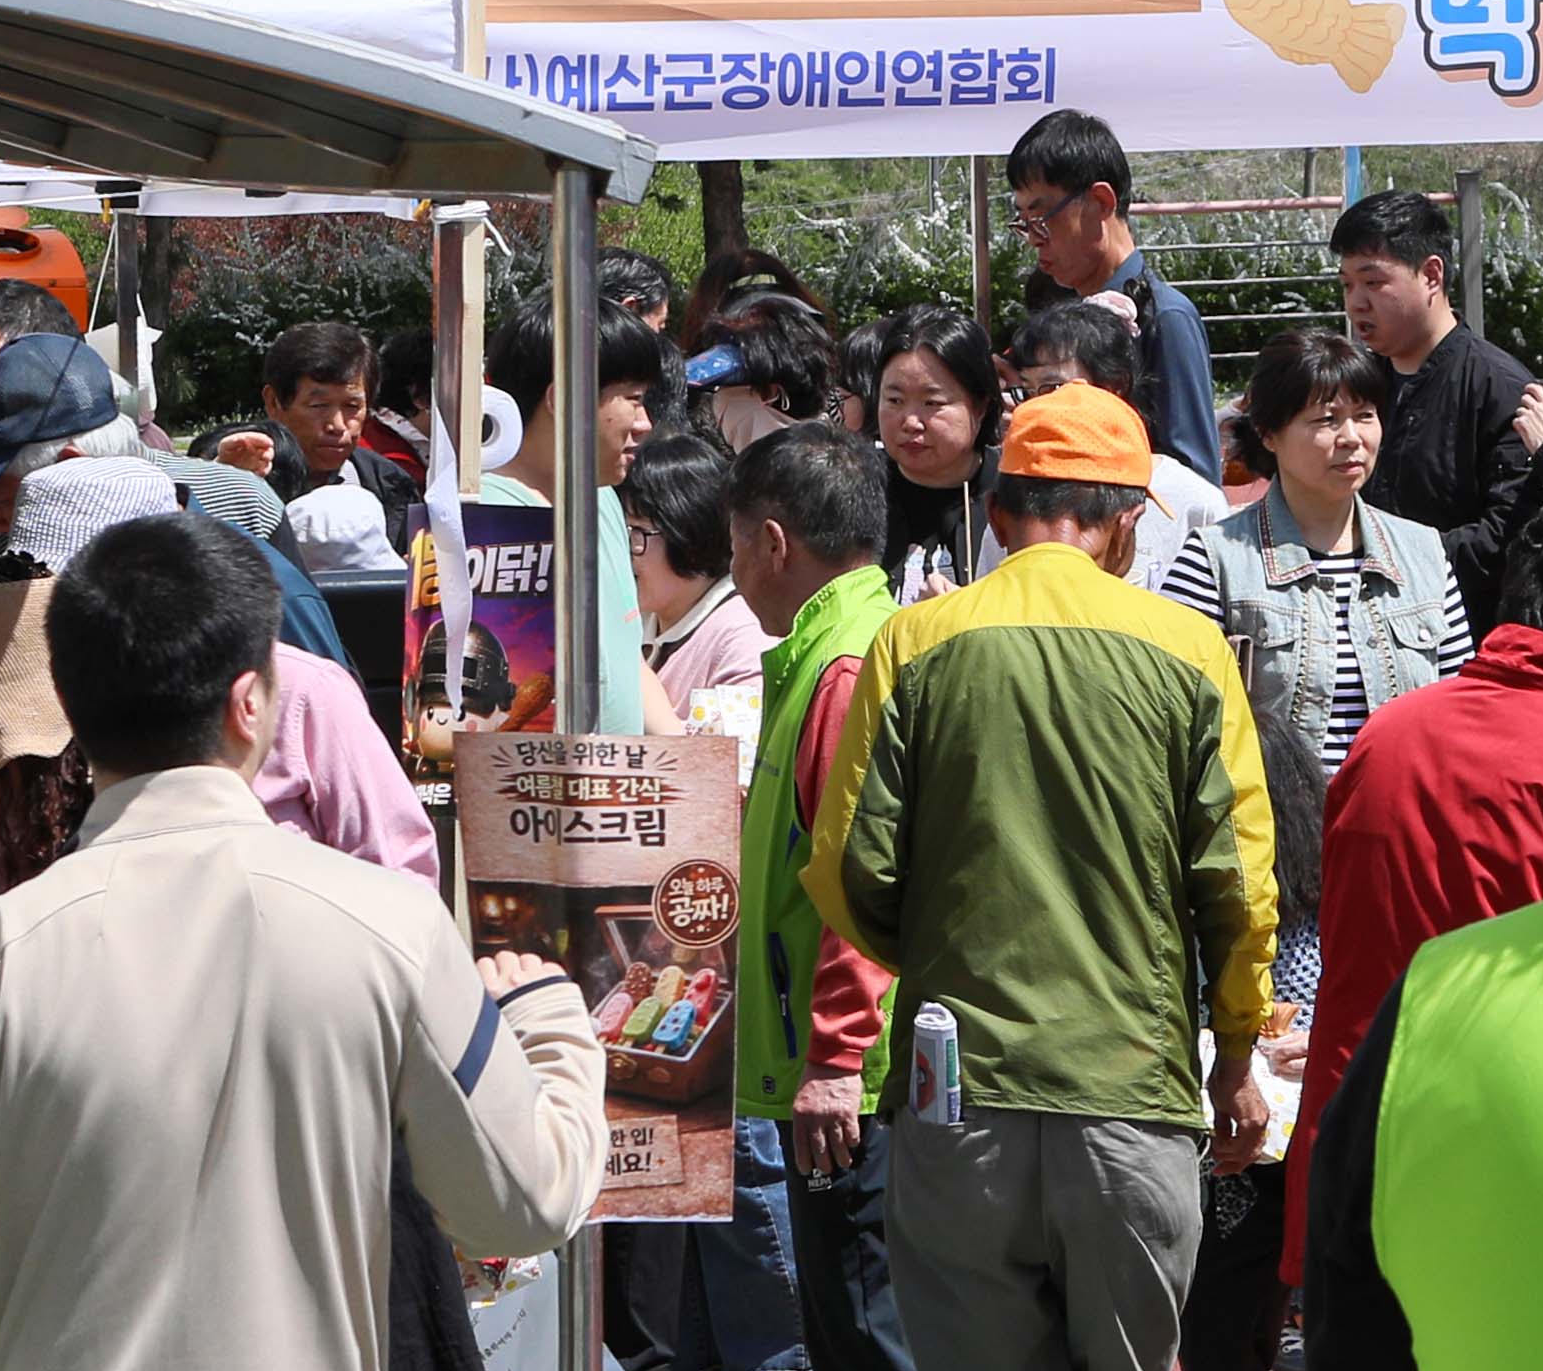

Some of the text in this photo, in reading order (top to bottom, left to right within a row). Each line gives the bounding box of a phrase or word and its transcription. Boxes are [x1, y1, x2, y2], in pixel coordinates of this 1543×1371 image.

[515, 740, 648, 770] 당신을 위한 날
[515, 774, 662, 804] 여름철 대표 간식
[509, 805, 666, 848] 아이스크림
[668, 876, 726, 897] 오늘 하루
[667, 893, 729, 928] 공짜!
[629, 1126, 654, 1147] 입!
